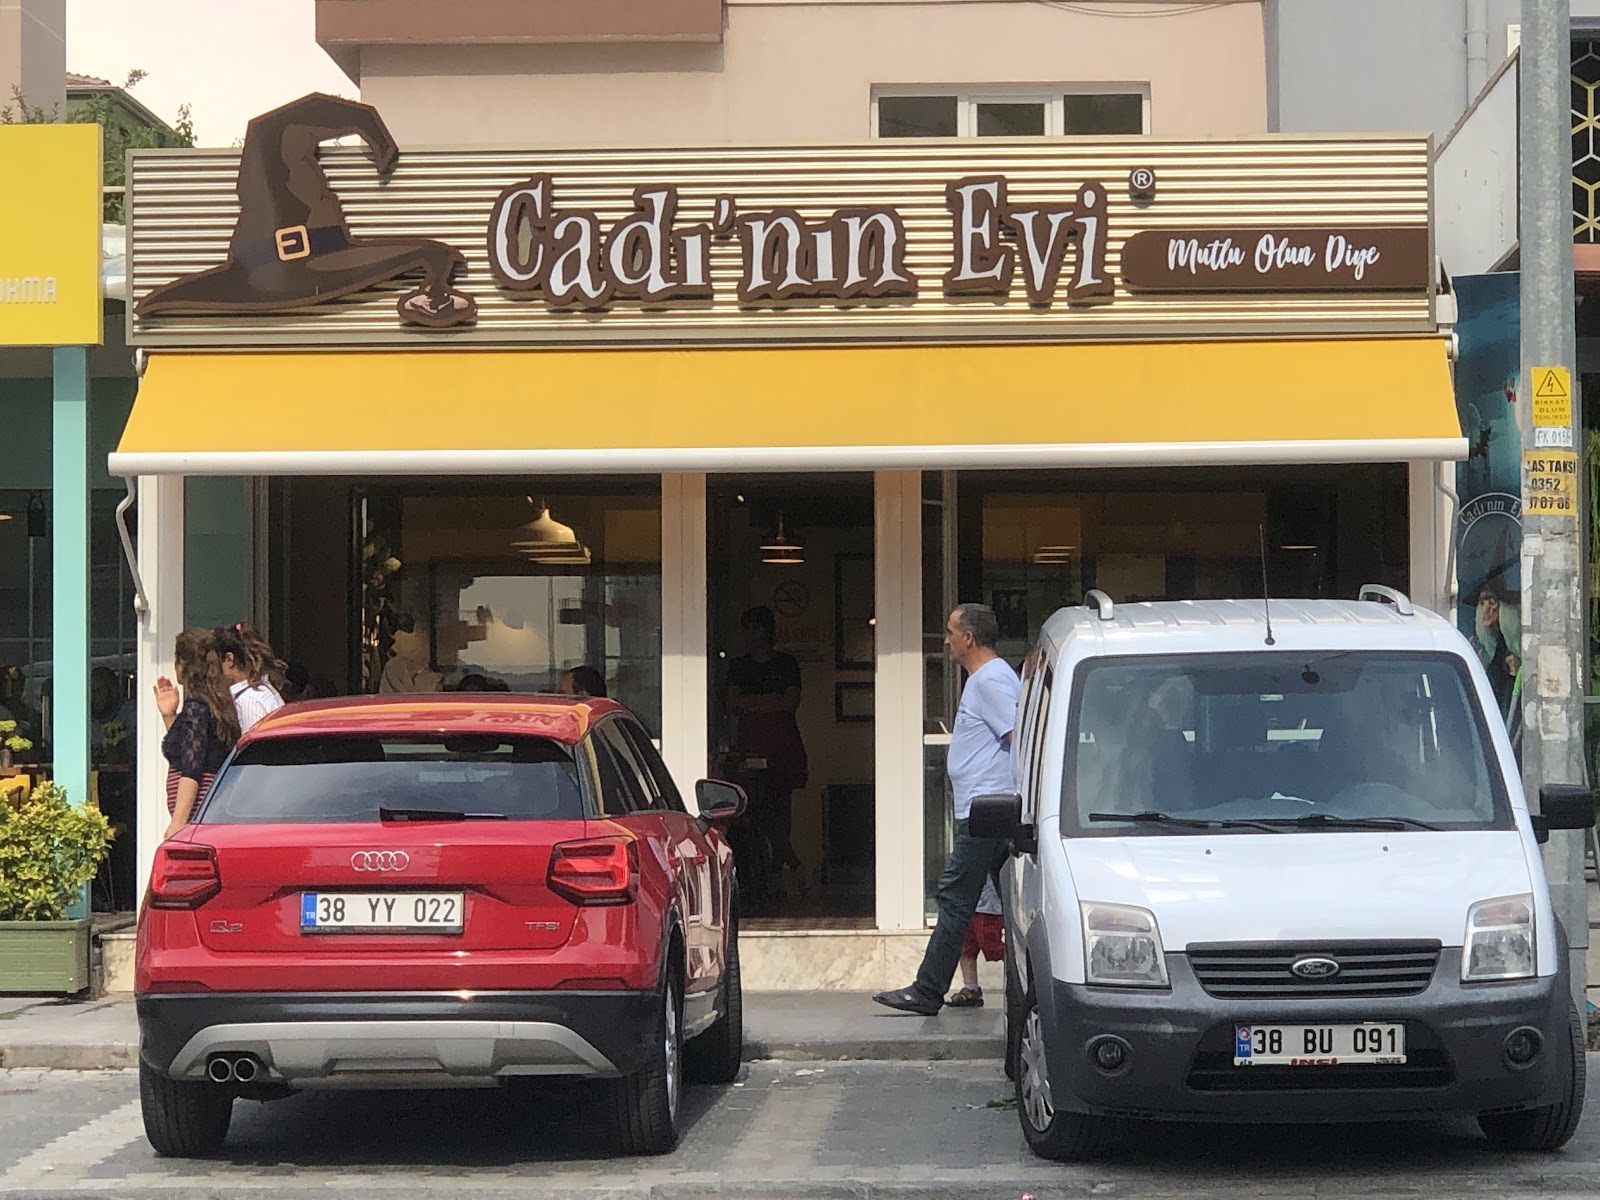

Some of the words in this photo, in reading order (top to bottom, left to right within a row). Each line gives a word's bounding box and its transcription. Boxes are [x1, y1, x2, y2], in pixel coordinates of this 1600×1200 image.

[951, 181, 1103, 292] Evi
[1168, 237, 1246, 275] Mutlu
[1254, 233, 1316, 274] Olun
[1324, 234, 1380, 281] Diye
[1531, 477, 1561, 490] 0352
[319, 897, 346, 923] 38
[368, 897, 397, 923] YY
[414, 897, 456, 923] 022
[210, 920, 243, 933] Q2
[1303, 962, 1329, 974] Ford
[1239, 1043, 1250, 1052] TR
[1253, 1029, 1283, 1054] 38
[1303, 1028, 1333, 1054] BU
[1353, 1028, 1397, 1053] 091
